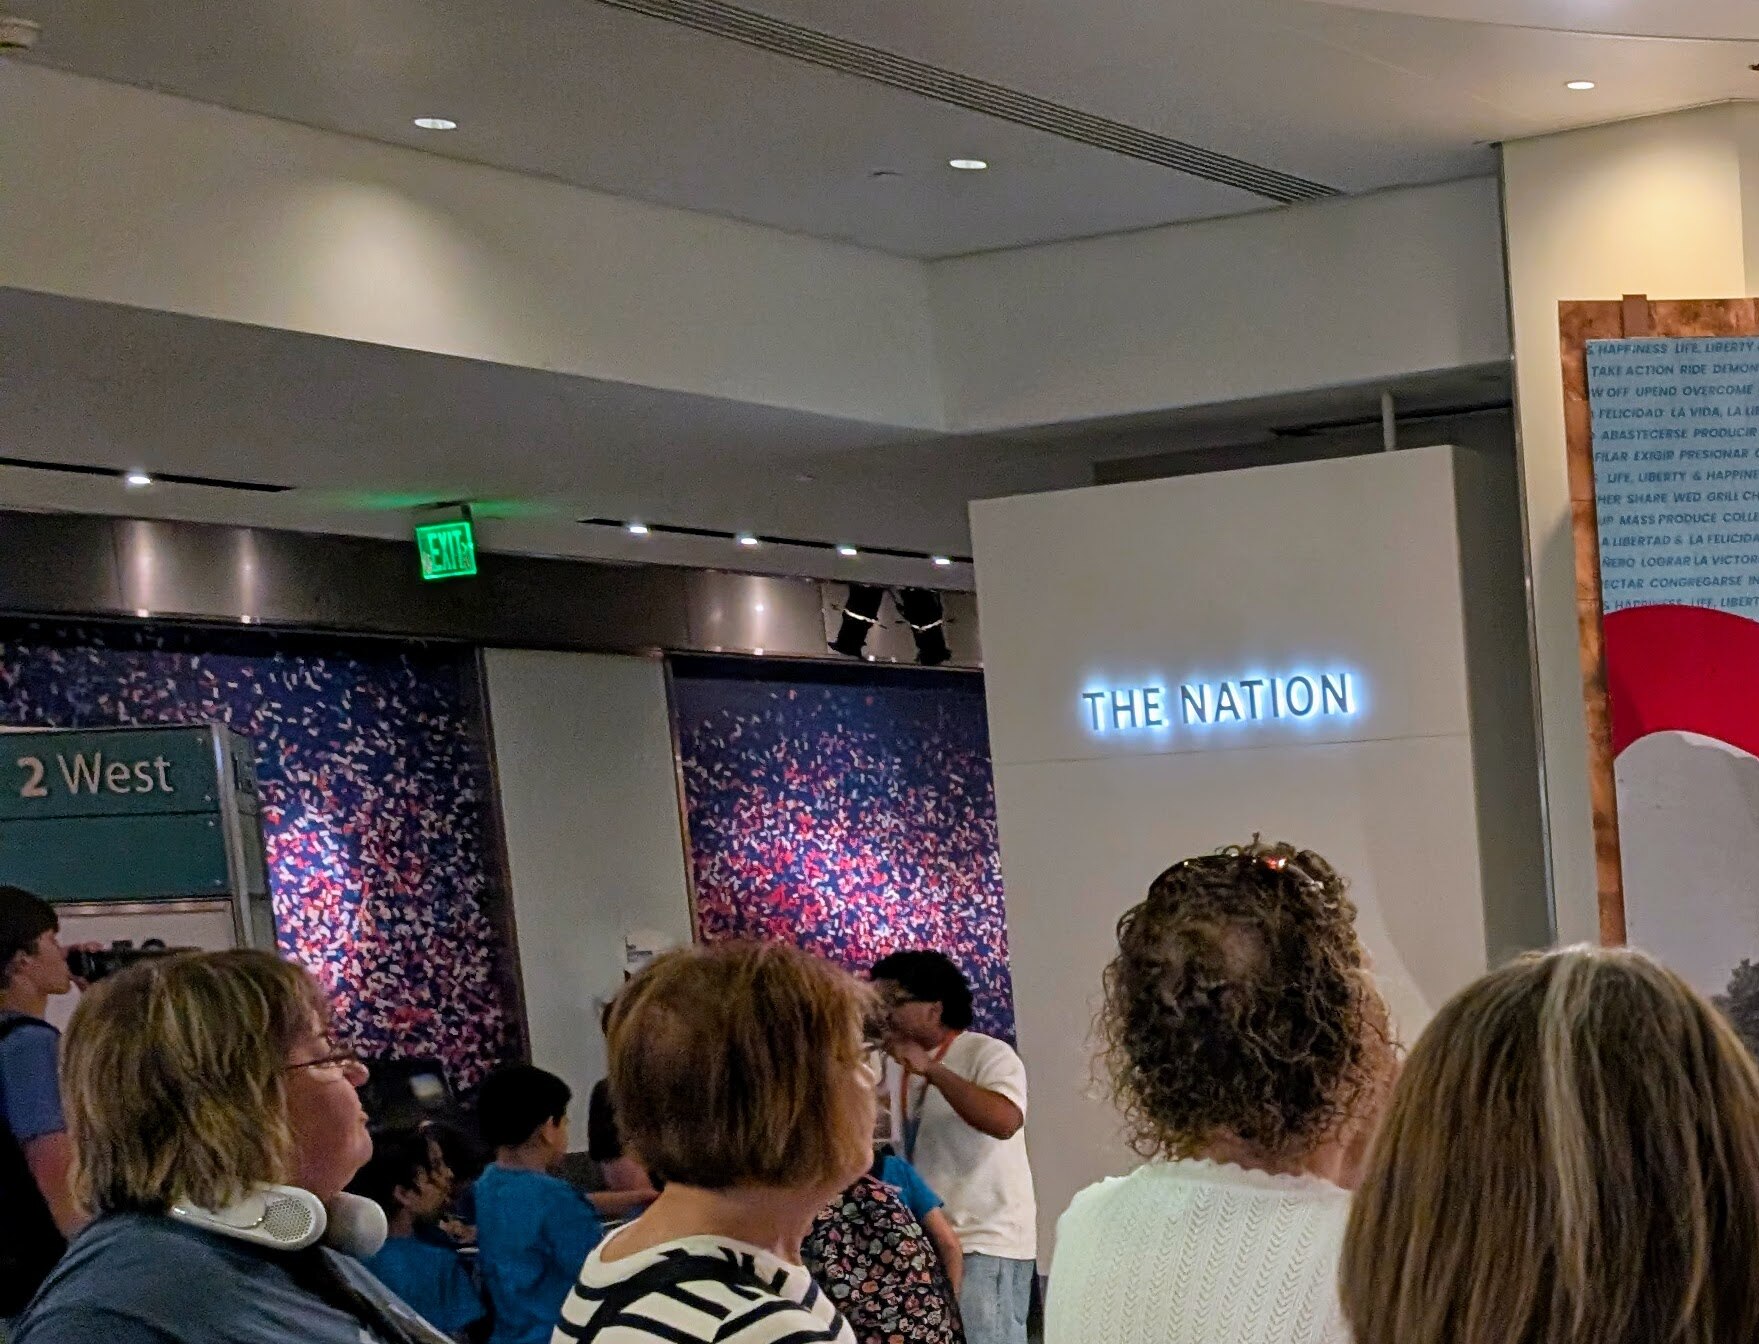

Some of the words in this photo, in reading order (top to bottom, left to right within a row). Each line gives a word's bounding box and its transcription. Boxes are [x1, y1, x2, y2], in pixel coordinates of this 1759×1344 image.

[1598, 342, 1668, 355] HAPPINESS
[1705, 341, 1754, 353] LIBERTY
[1625, 364, 1674, 376] ACTION
[1680, 363, 1707, 376] RIDE
[1635, 385, 1677, 397] UPEND
[1683, 384, 1753, 396] OVERCOME
[1728, 405, 1742, 417] LA
[1694, 426, 1758, 438] PRODUCIR
[1626, 492, 1667, 504] SHARE
[1619, 514, 1655, 526] MASS
[1658, 512, 1717, 525] PRODUCE
[1613, 535, 1671, 547] LIBERTAD
[1689, 534, 1704, 546] LA
[426, 529, 463, 573] EXIT
[1695, 554, 1708, 566] LA
[1650, 576, 1742, 589] CONGREGARSE
[1082, 687, 1163, 731] THE
[1179, 672, 1355, 725] NATION
[17, 756, 48, 798] 2
[56, 751, 174, 794] West
